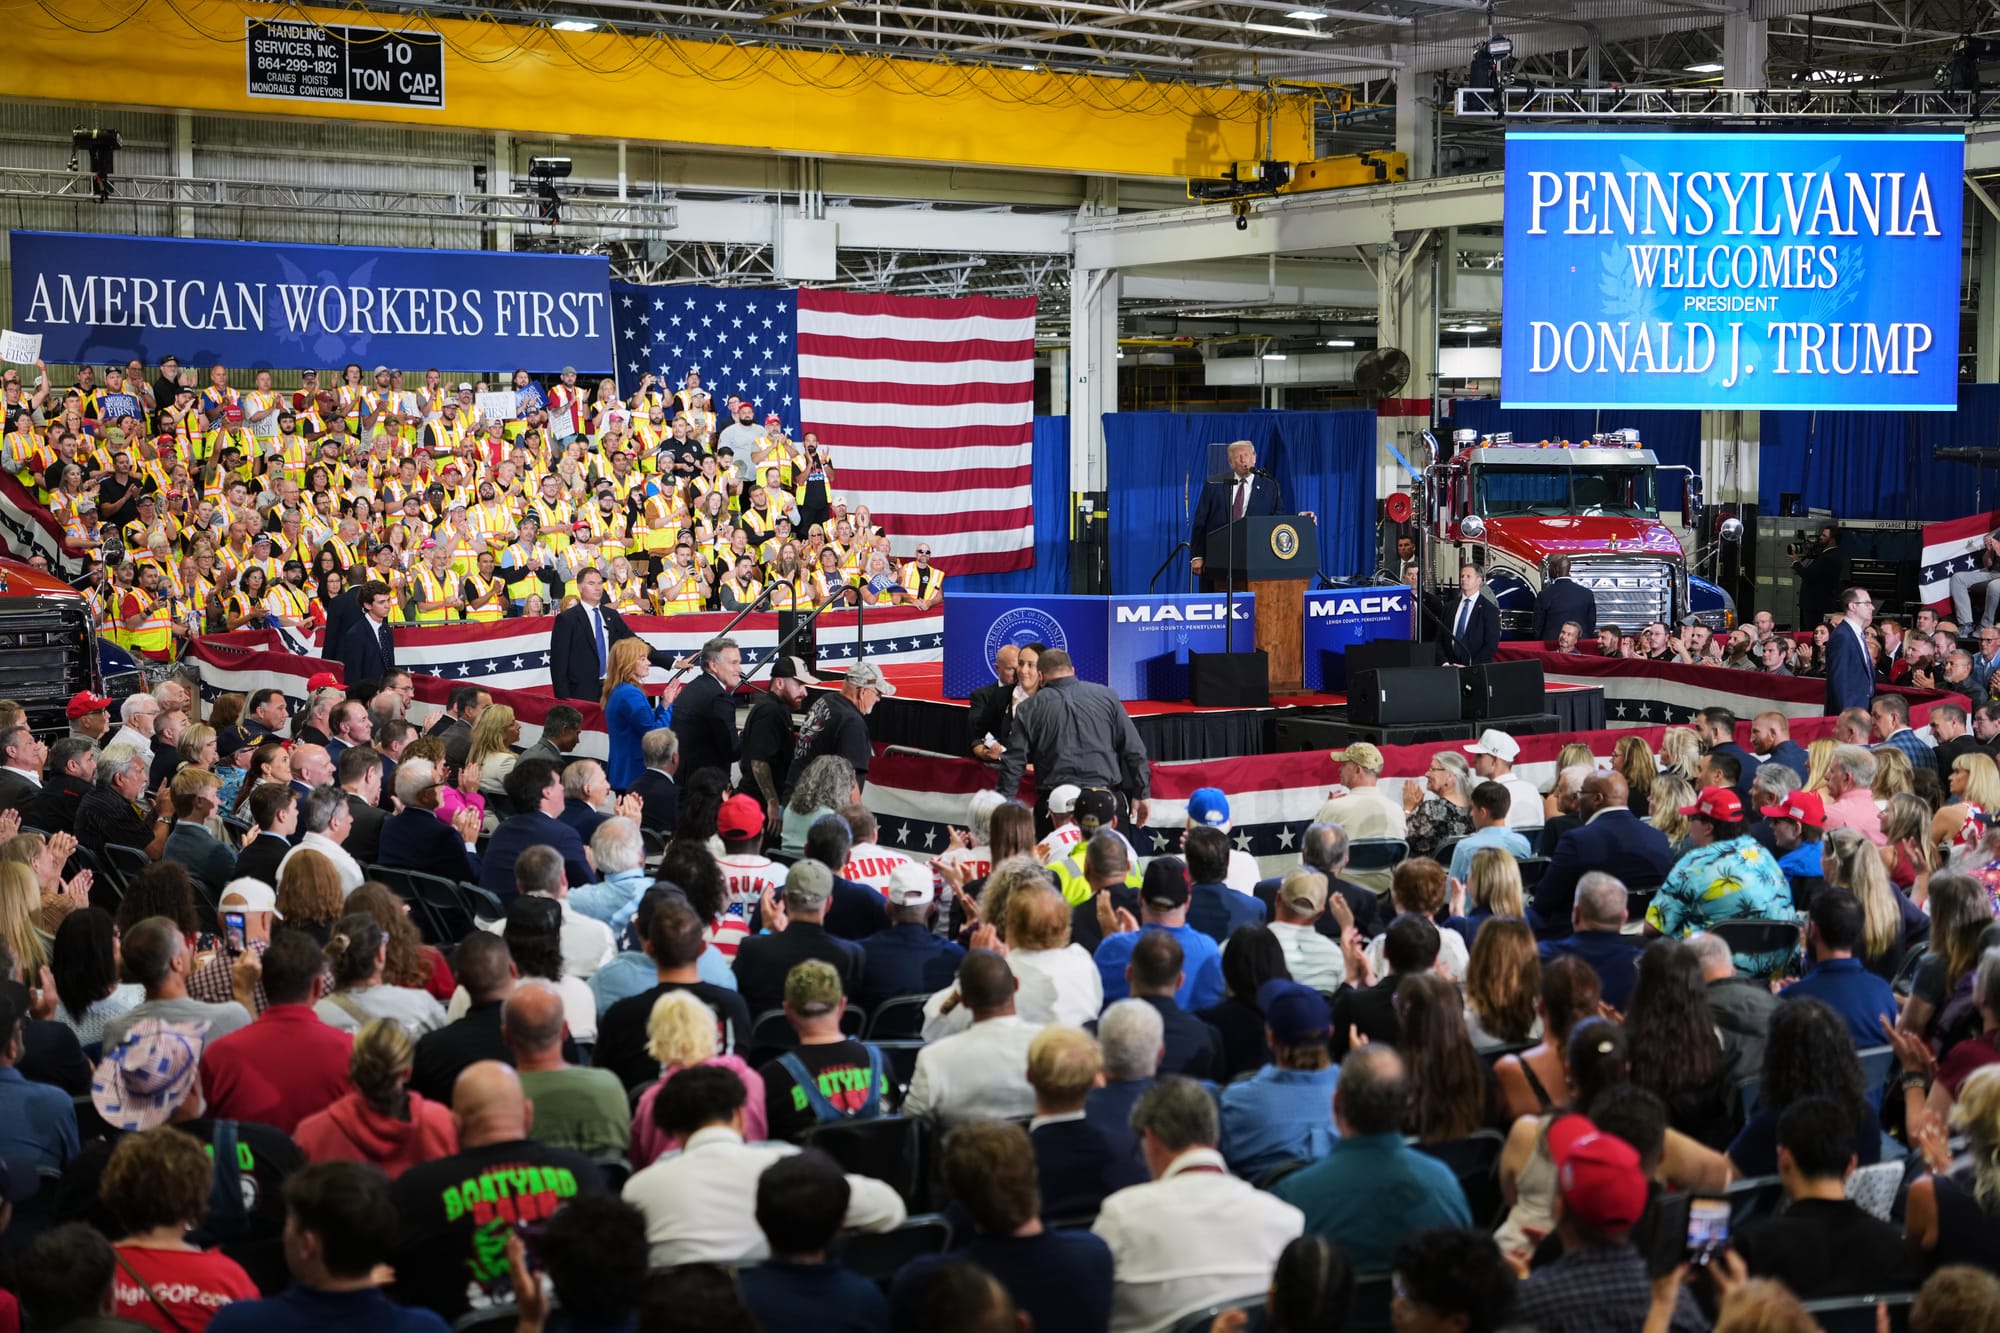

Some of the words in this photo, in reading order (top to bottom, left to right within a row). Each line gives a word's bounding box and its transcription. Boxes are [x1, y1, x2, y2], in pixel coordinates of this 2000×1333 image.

[267, 24, 326, 41] HANDLING
[254, 40, 315, 59] SERVICES,
[317, 45, 339, 59] INC.
[384, 42, 413, 64] 10
[257, 57, 337, 74] 864-299-1821
[267, 72, 297, 83] CRANES
[302, 75, 329, 86] HOISTS
[352, 68, 391, 92] TON
[399, 72, 440, 95] CAP.
[251, 82, 295, 95] MONORAILS
[300, 85, 344, 98] CONVEYORS
[1527, 171, 1941, 237] PENNSYLVANIA
[1627, 244, 1838, 289] WELCOMES
[25, 273, 267, 331] AMERICAN
[276, 283, 483, 337] WORKERS
[494, 290, 604, 338] FIRST
[1684, 297, 1778, 312] PRESIDENT
[5, 348, 36, 362] FIRST
[1529, 321, 1715, 374] DONALD
[1722, 322, 1754, 388] J.
[1767, 322, 1933, 376] TRUMP
[107, 407, 135, 417] FIRST
[483, 407, 509, 419] FIRST
[987, 610, 1026, 647] PRESIDENT
[1037, 614, 1049, 624] THE
[1048, 621, 1065, 650] UNITE
[1160, 624, 1185, 632] COUNTY,
[442, 1166, 578, 1222] BOATYARD
